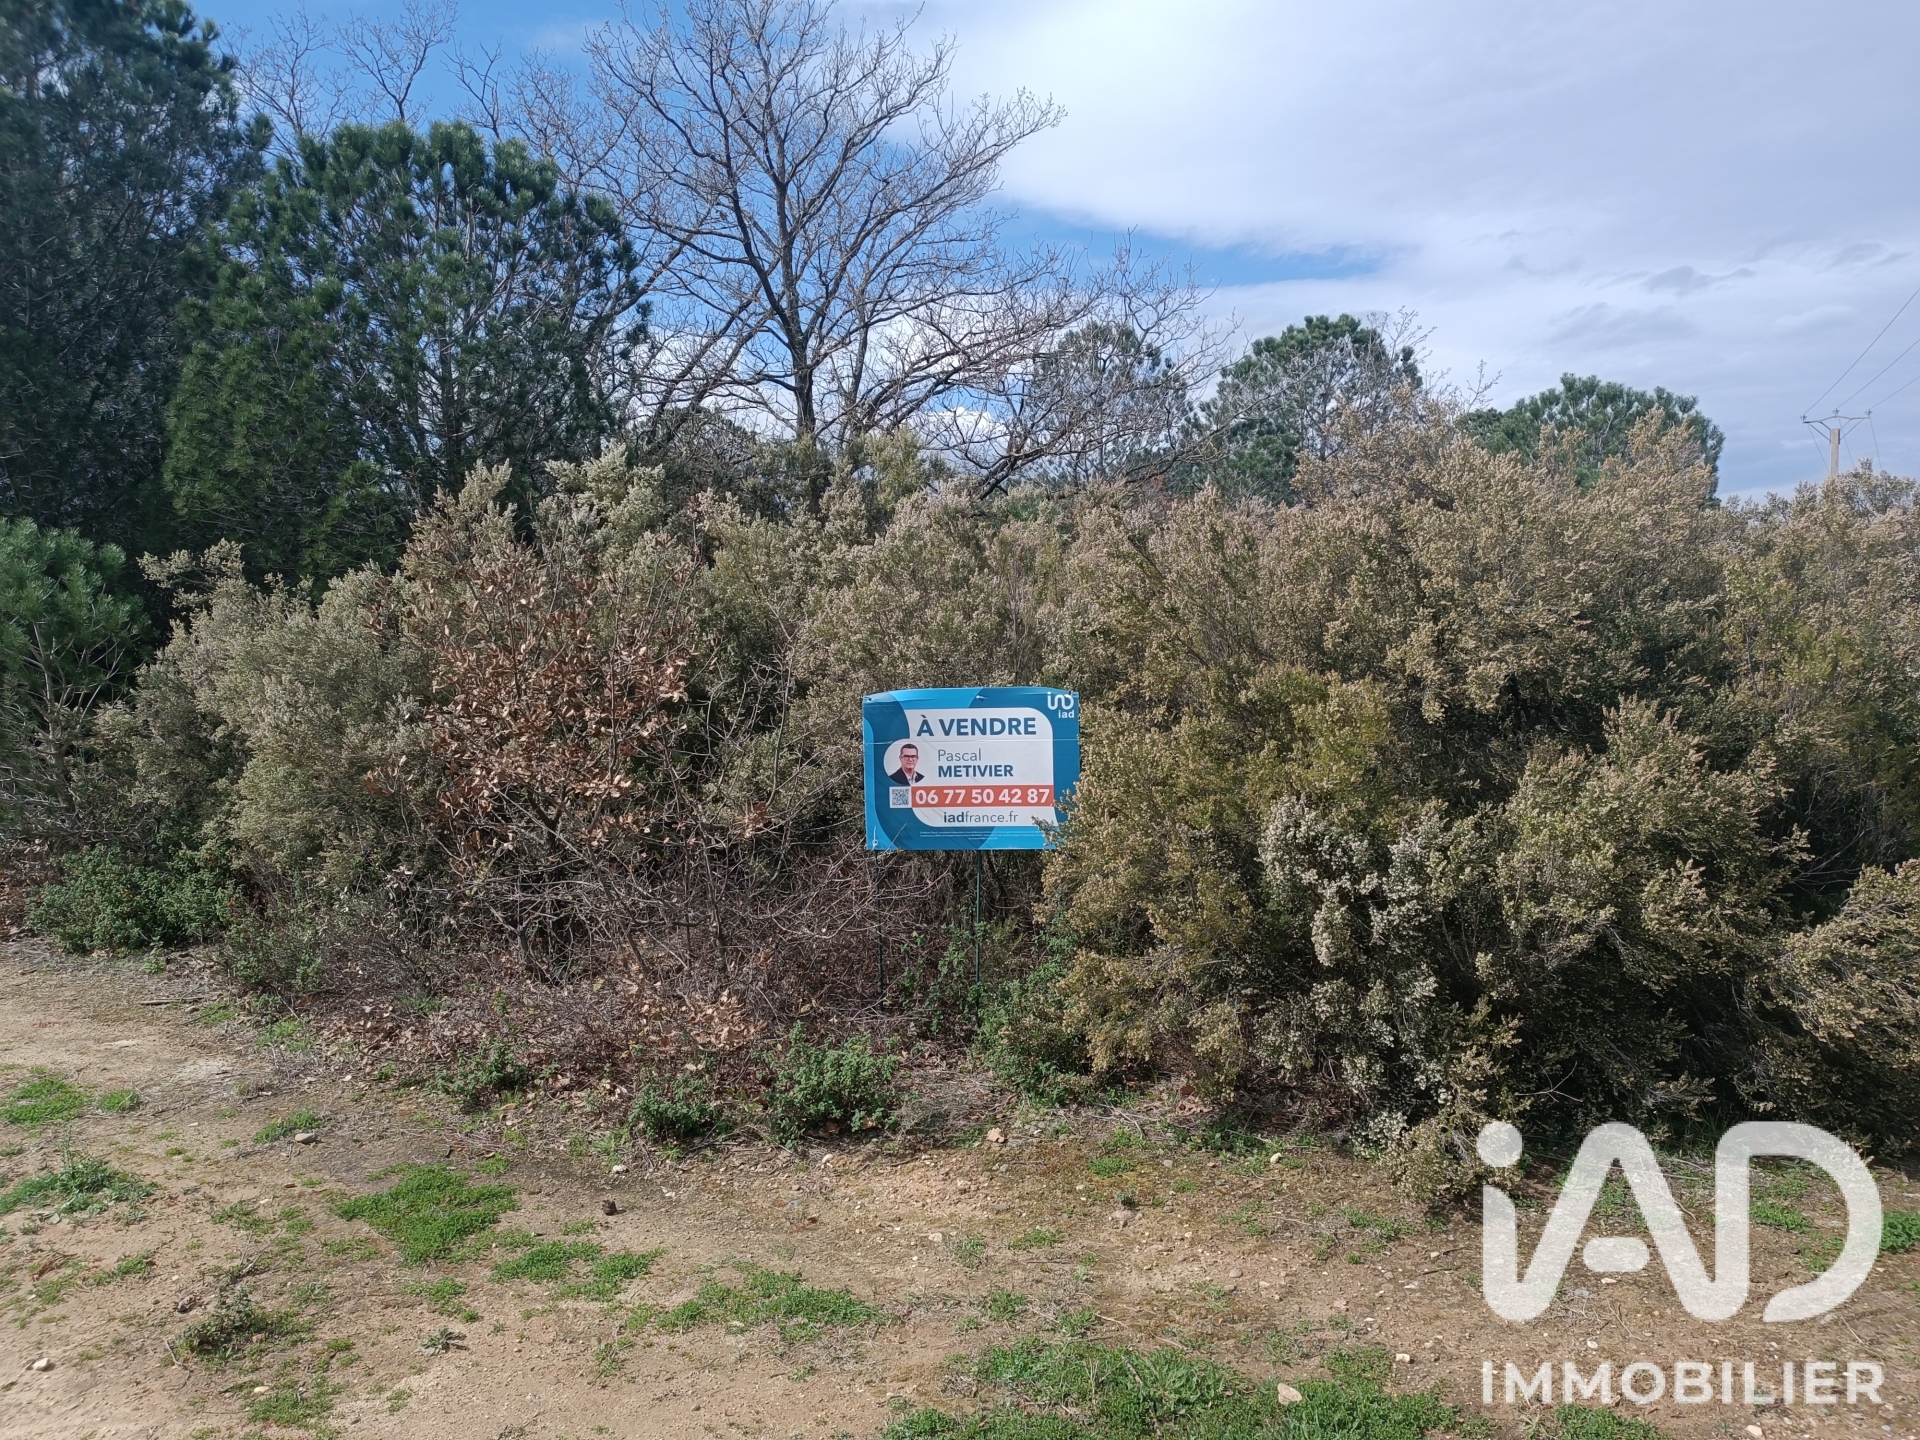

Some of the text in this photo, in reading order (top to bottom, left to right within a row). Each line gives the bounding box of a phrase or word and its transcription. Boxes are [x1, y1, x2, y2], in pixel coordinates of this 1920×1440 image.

[1058, 710, 1075, 719] iad
[916, 714, 1037, 737] À VENDRE
[937, 748, 982, 762] Pascal
[938, 764, 1014, 778] METIVIER
[915, 788, 1050, 805] 06 77 50 42 87
[943, 811, 1019, 824] iadfrance.fr
